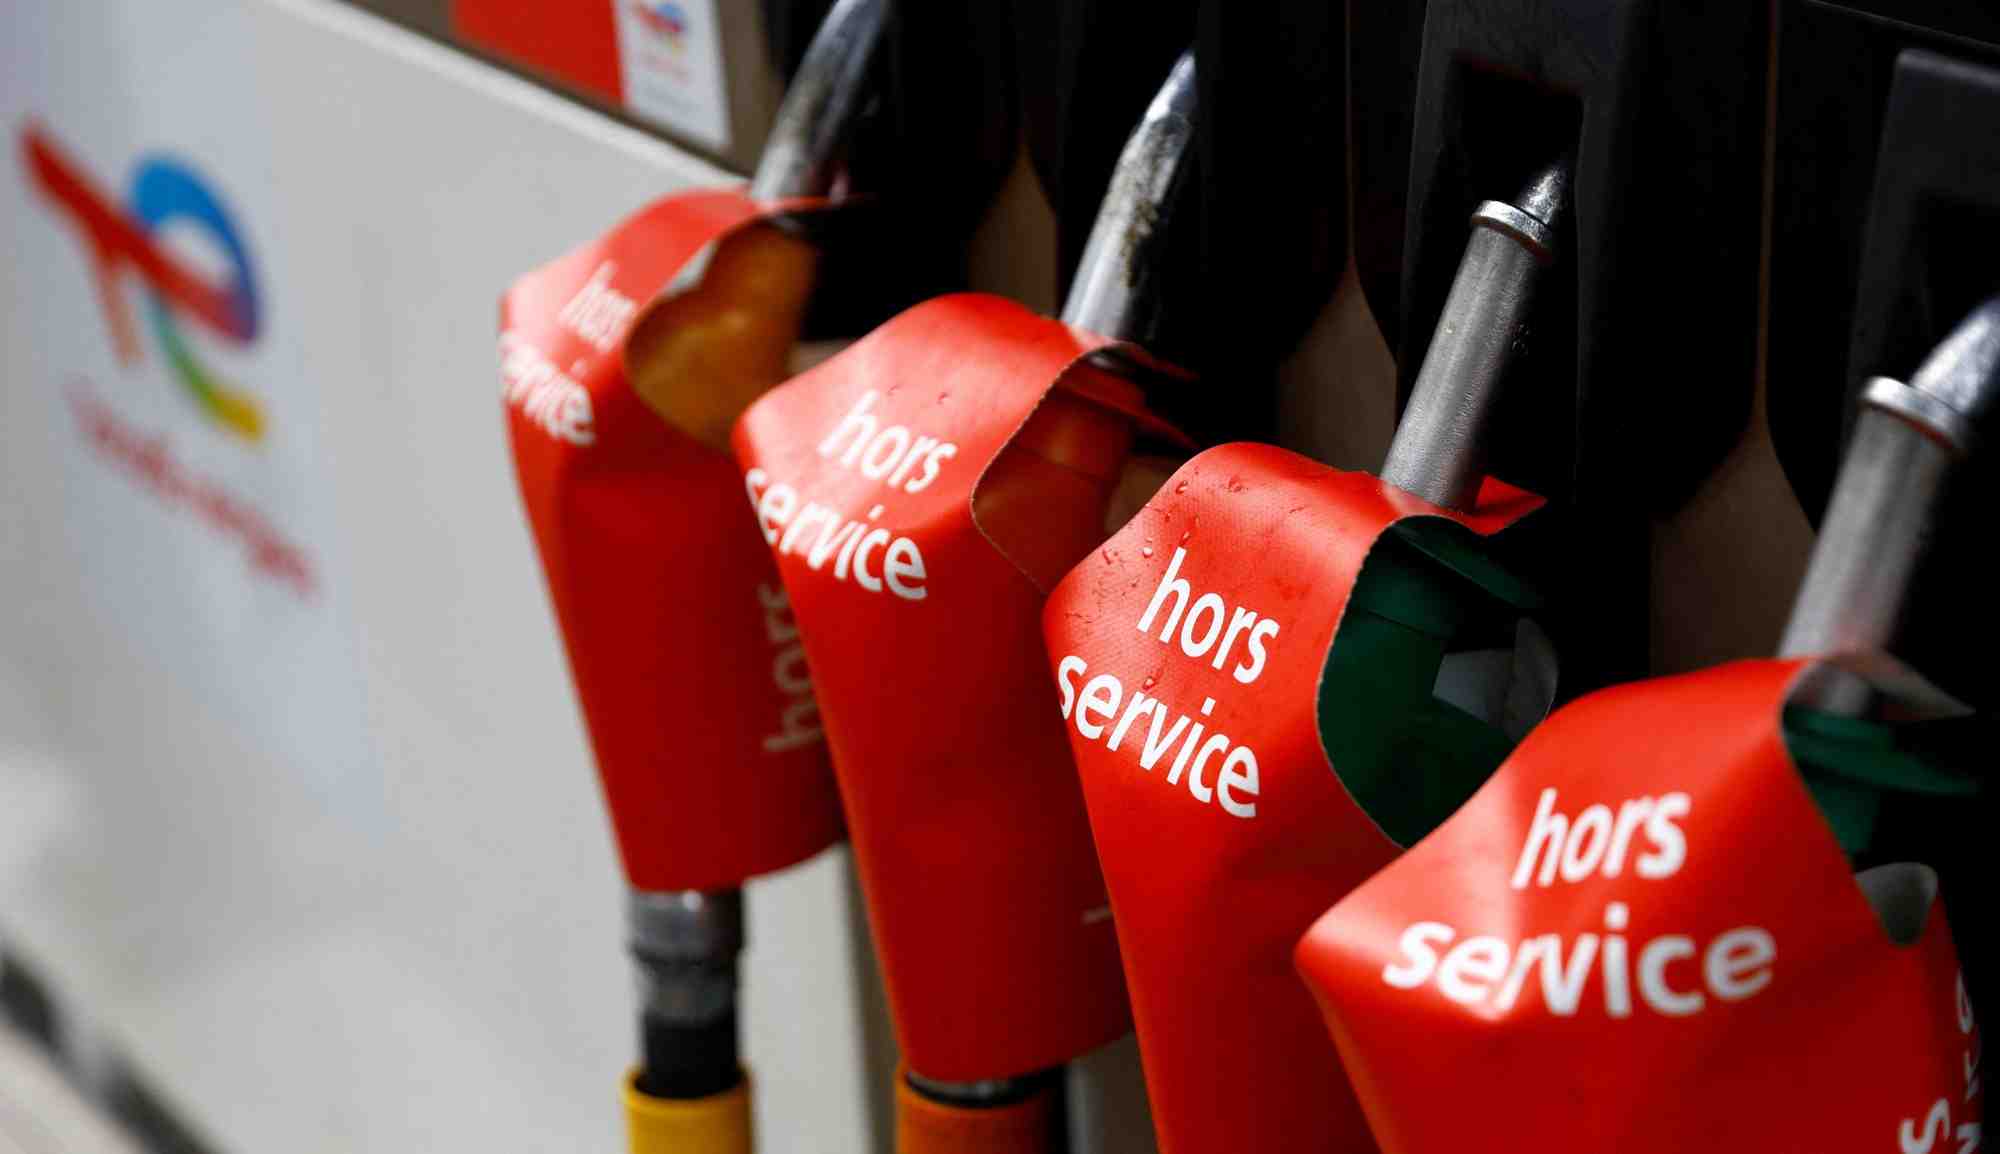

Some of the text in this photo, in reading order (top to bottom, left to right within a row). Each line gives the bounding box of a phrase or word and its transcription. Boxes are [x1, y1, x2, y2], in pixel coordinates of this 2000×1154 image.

[817, 389, 958, 492] hors
[1137, 546, 1280, 684] hors
[1058, 655, 1260, 819] service
[1511, 787, 1692, 890] hors
[1381, 902, 1777, 1021] service
